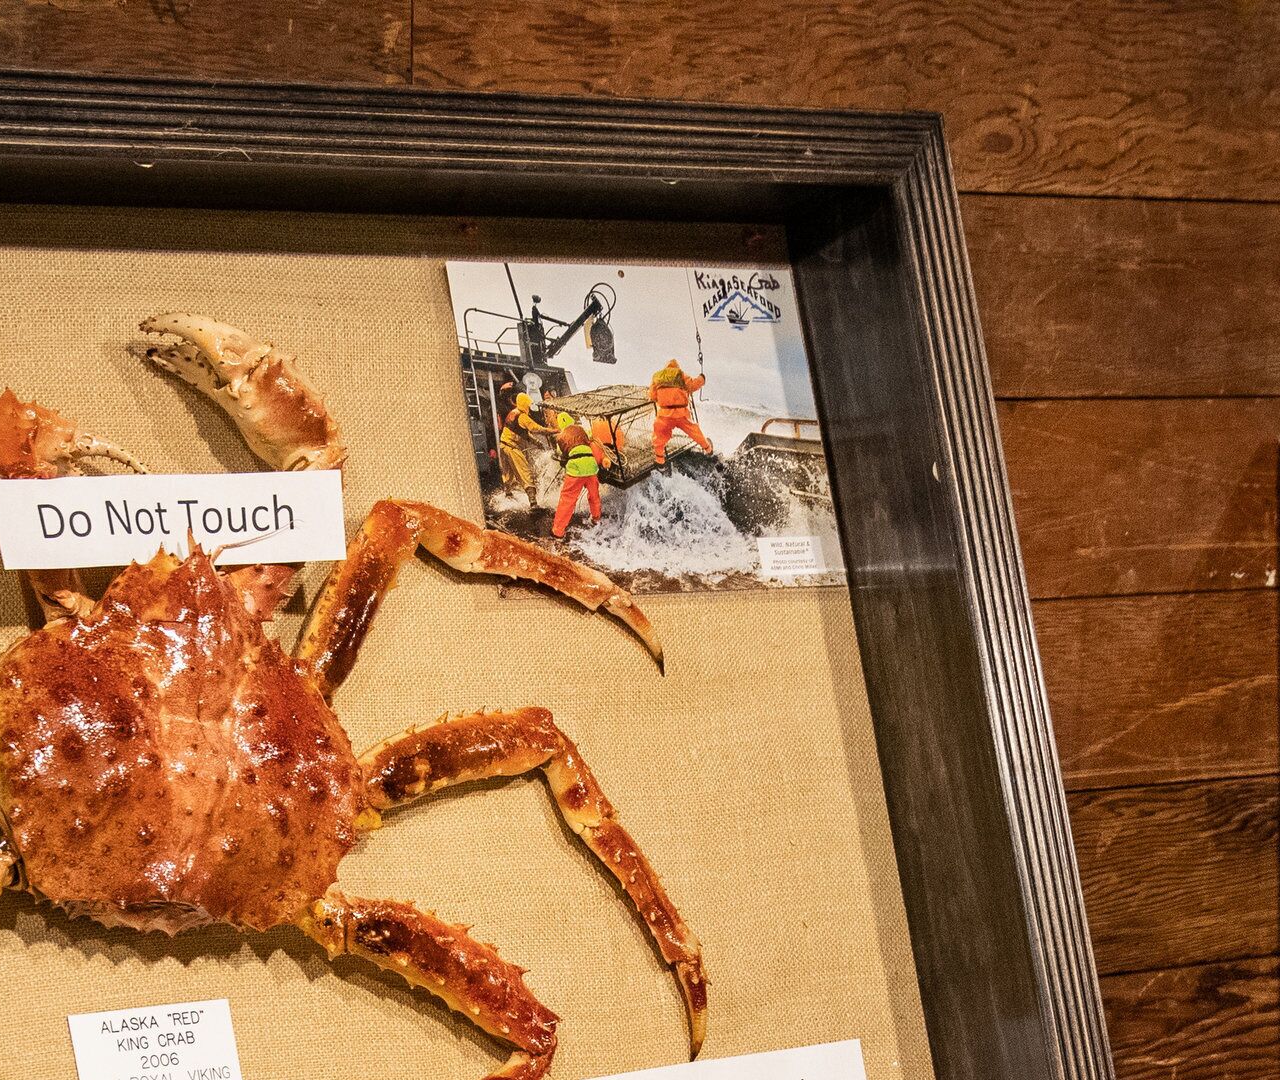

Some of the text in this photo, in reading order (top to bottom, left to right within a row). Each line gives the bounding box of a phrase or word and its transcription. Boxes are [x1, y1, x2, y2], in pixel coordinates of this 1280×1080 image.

[695, 270, 780, 299] King Crab
[703, 282, 733, 318] ALASA
[37, 494, 295, 539] Do Not Touch
[101, 1010, 204, 1034] ALASKA "RED"
[117, 1031, 196, 1052] KING CRAB
[140, 1052, 180, 1069] 2006
